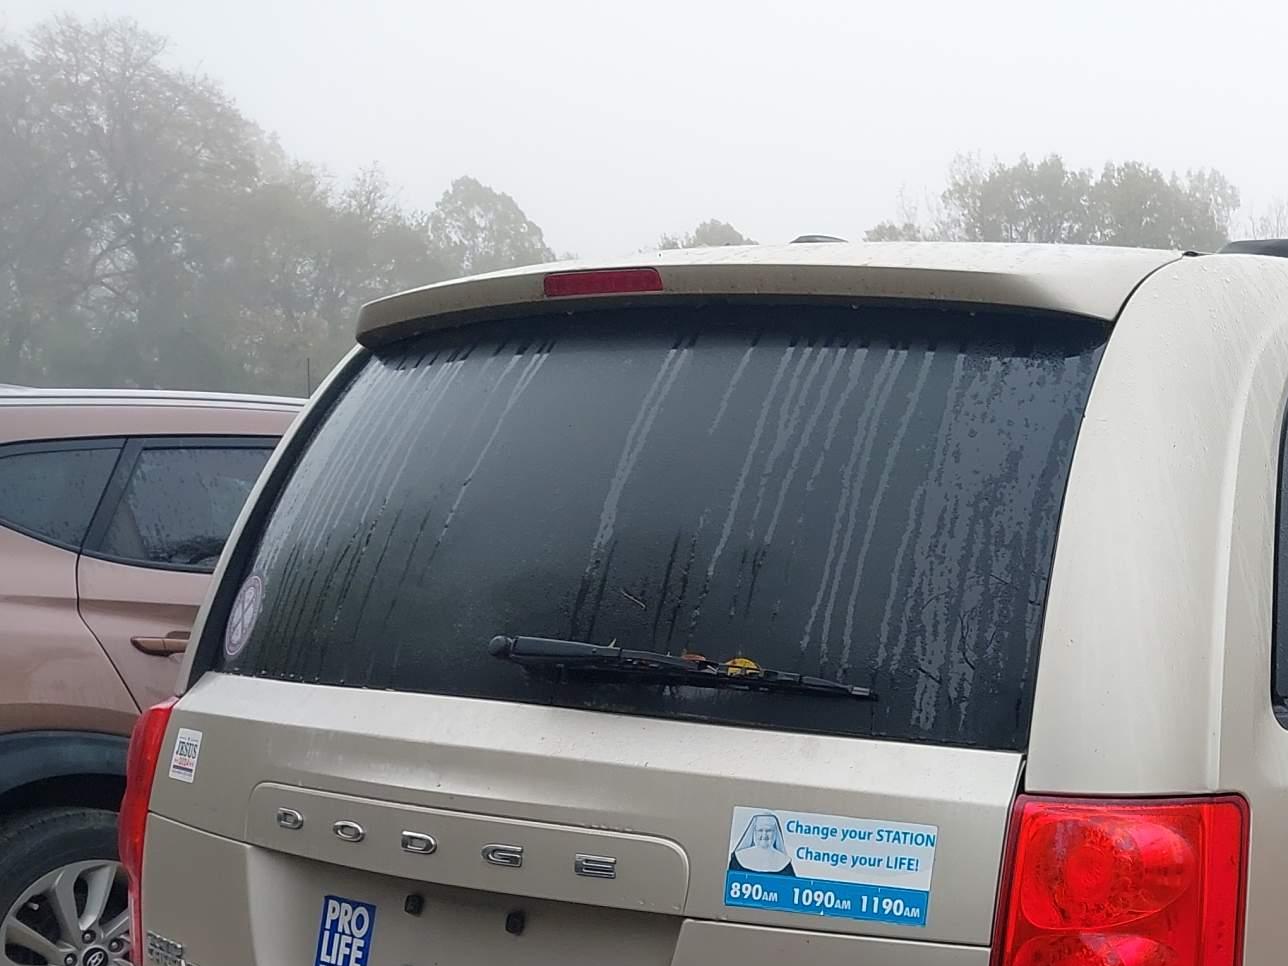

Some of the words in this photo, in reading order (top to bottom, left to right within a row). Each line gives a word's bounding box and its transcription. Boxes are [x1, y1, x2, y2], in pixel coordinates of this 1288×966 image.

[176, 741, 197, 759] JESUS
[276, 807, 617, 880] DODGE
[786, 820, 838, 840] Change
[840, 828, 873, 842] your
[876, 829, 936, 848] STATION
[796, 847, 848, 866] Change
[851, 854, 883, 868] your
[886, 856, 920, 872] LIFE!
[325, 899, 370, 938] PRO
